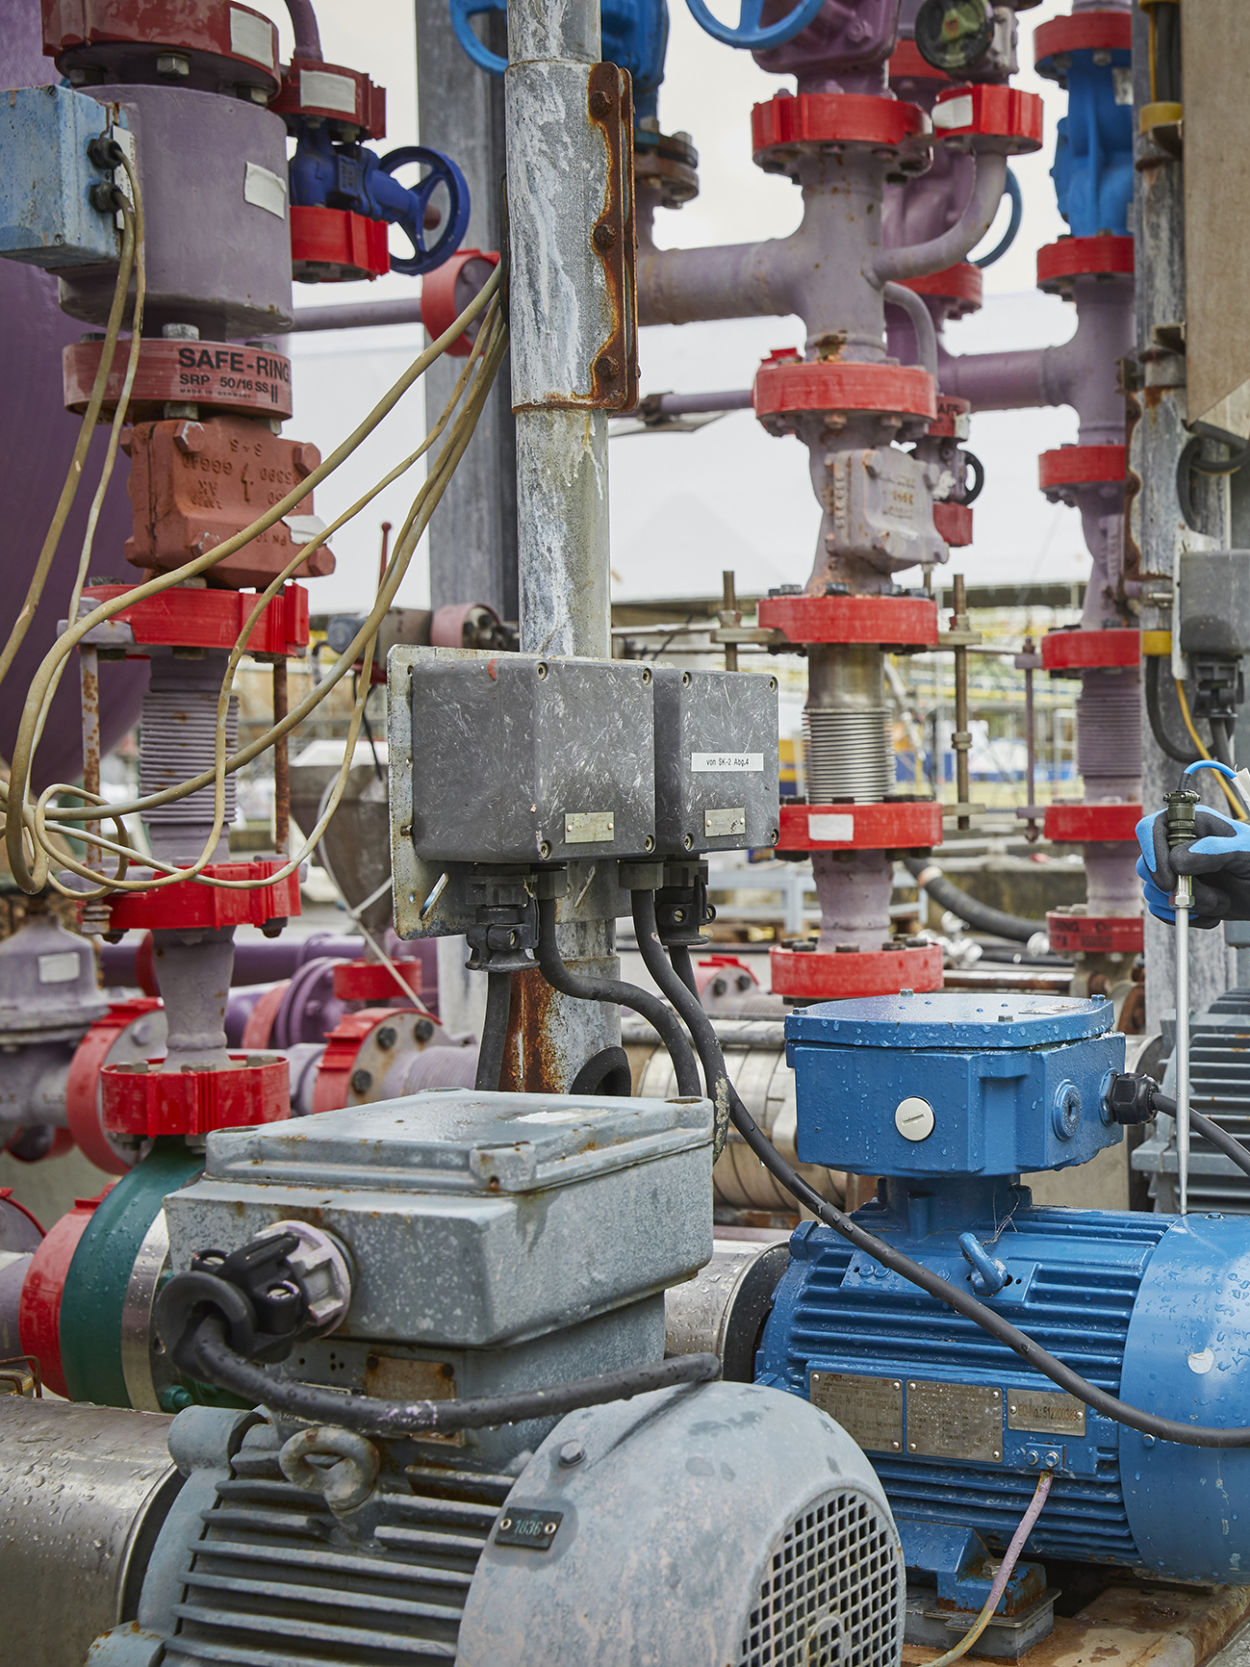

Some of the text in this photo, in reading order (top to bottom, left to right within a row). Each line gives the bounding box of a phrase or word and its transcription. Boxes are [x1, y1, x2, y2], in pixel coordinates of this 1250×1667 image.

[179, 348, 290, 383] SAFE-RING
[180, 374, 210, 386] SRP
[220, 377, 253, 391] 50/16
